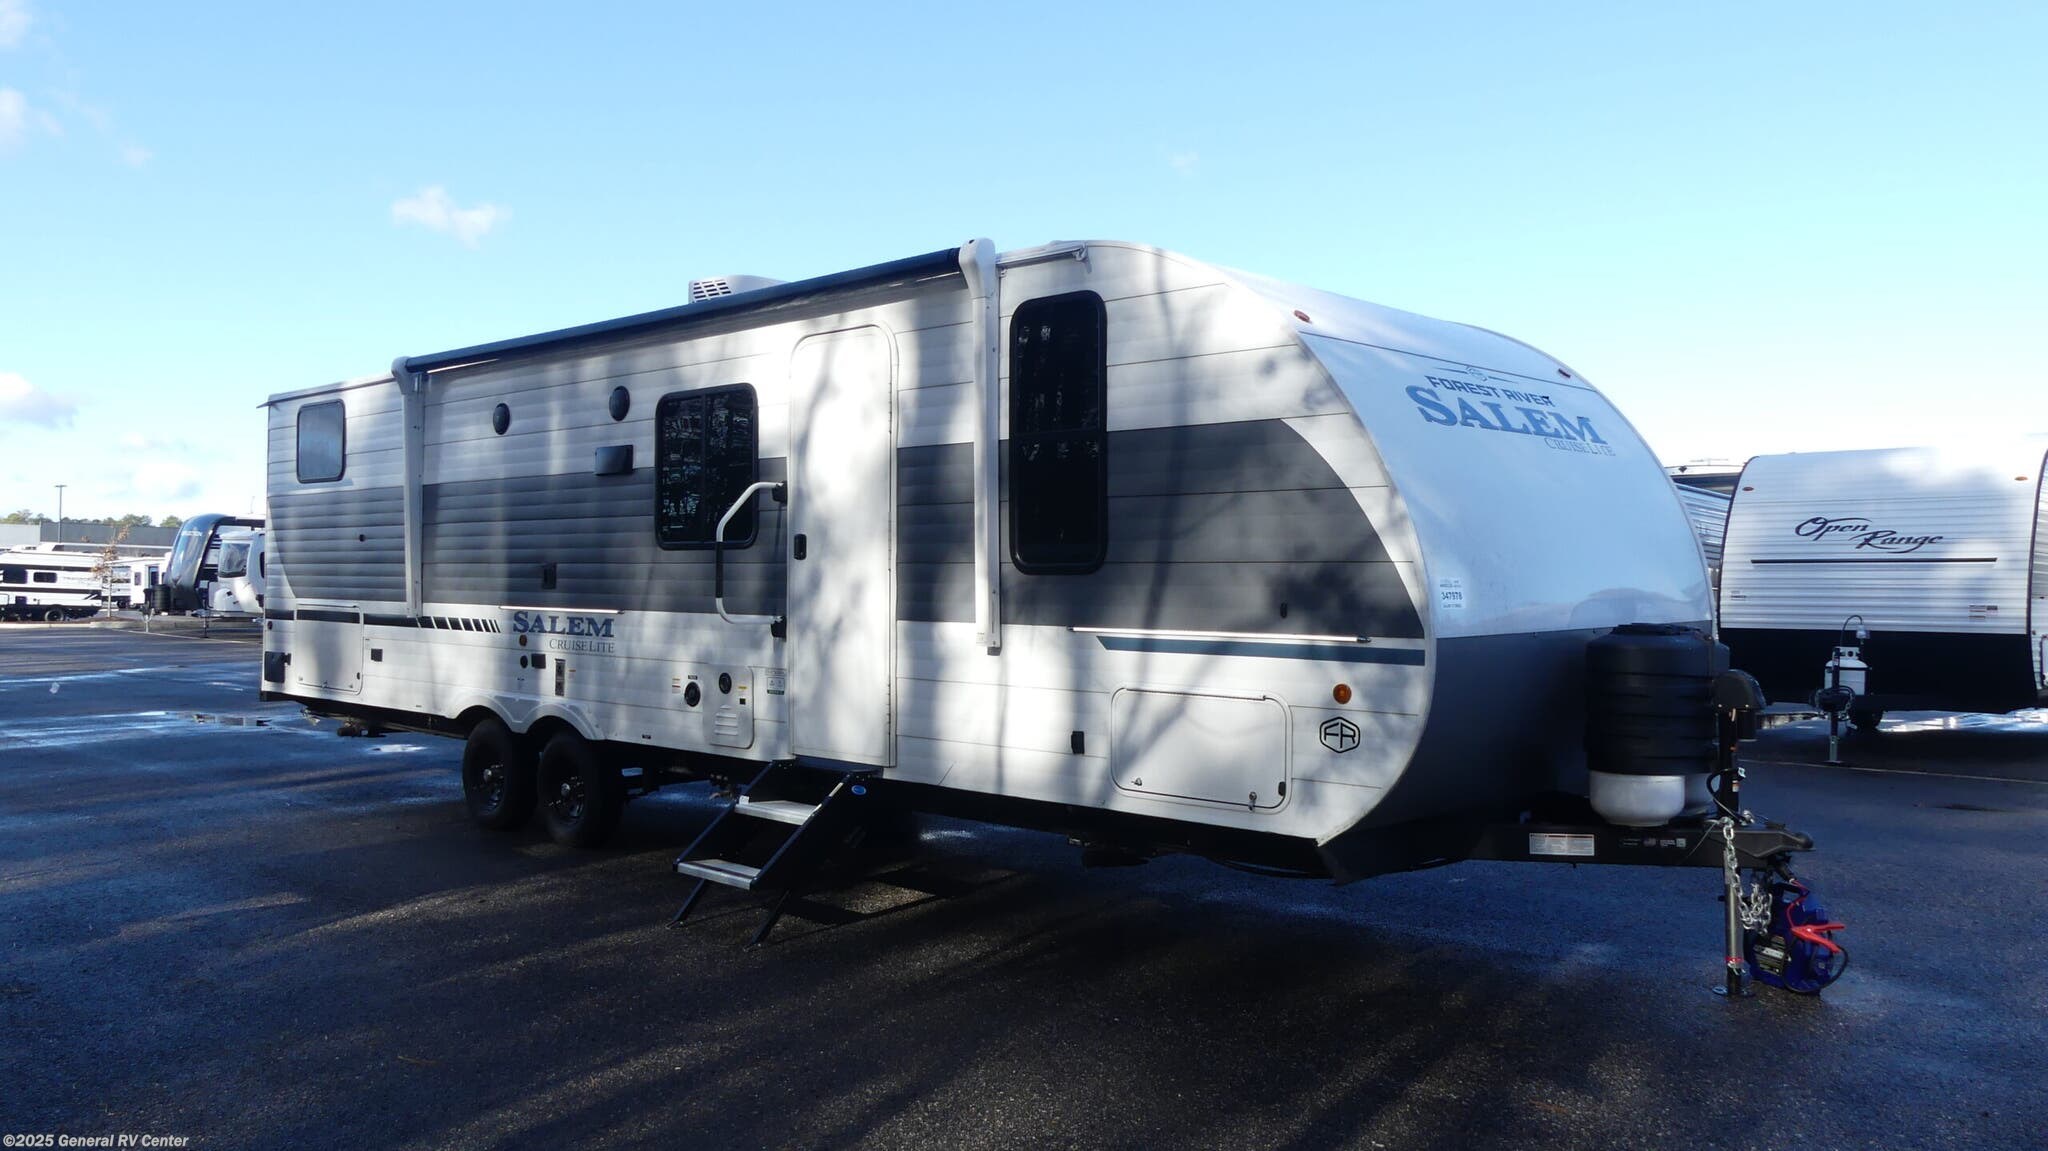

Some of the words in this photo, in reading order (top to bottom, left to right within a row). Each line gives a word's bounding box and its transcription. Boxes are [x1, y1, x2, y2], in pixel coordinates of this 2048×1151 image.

[1424, 376, 1500, 398] FOREST
[1501, 389, 1556, 407] RIVER
[1405, 385, 1608, 445] SALEM
[1795, 517, 1872, 541] Open
[1848, 530, 1943, 554] Range
[513, 610, 615, 638] SALEM
